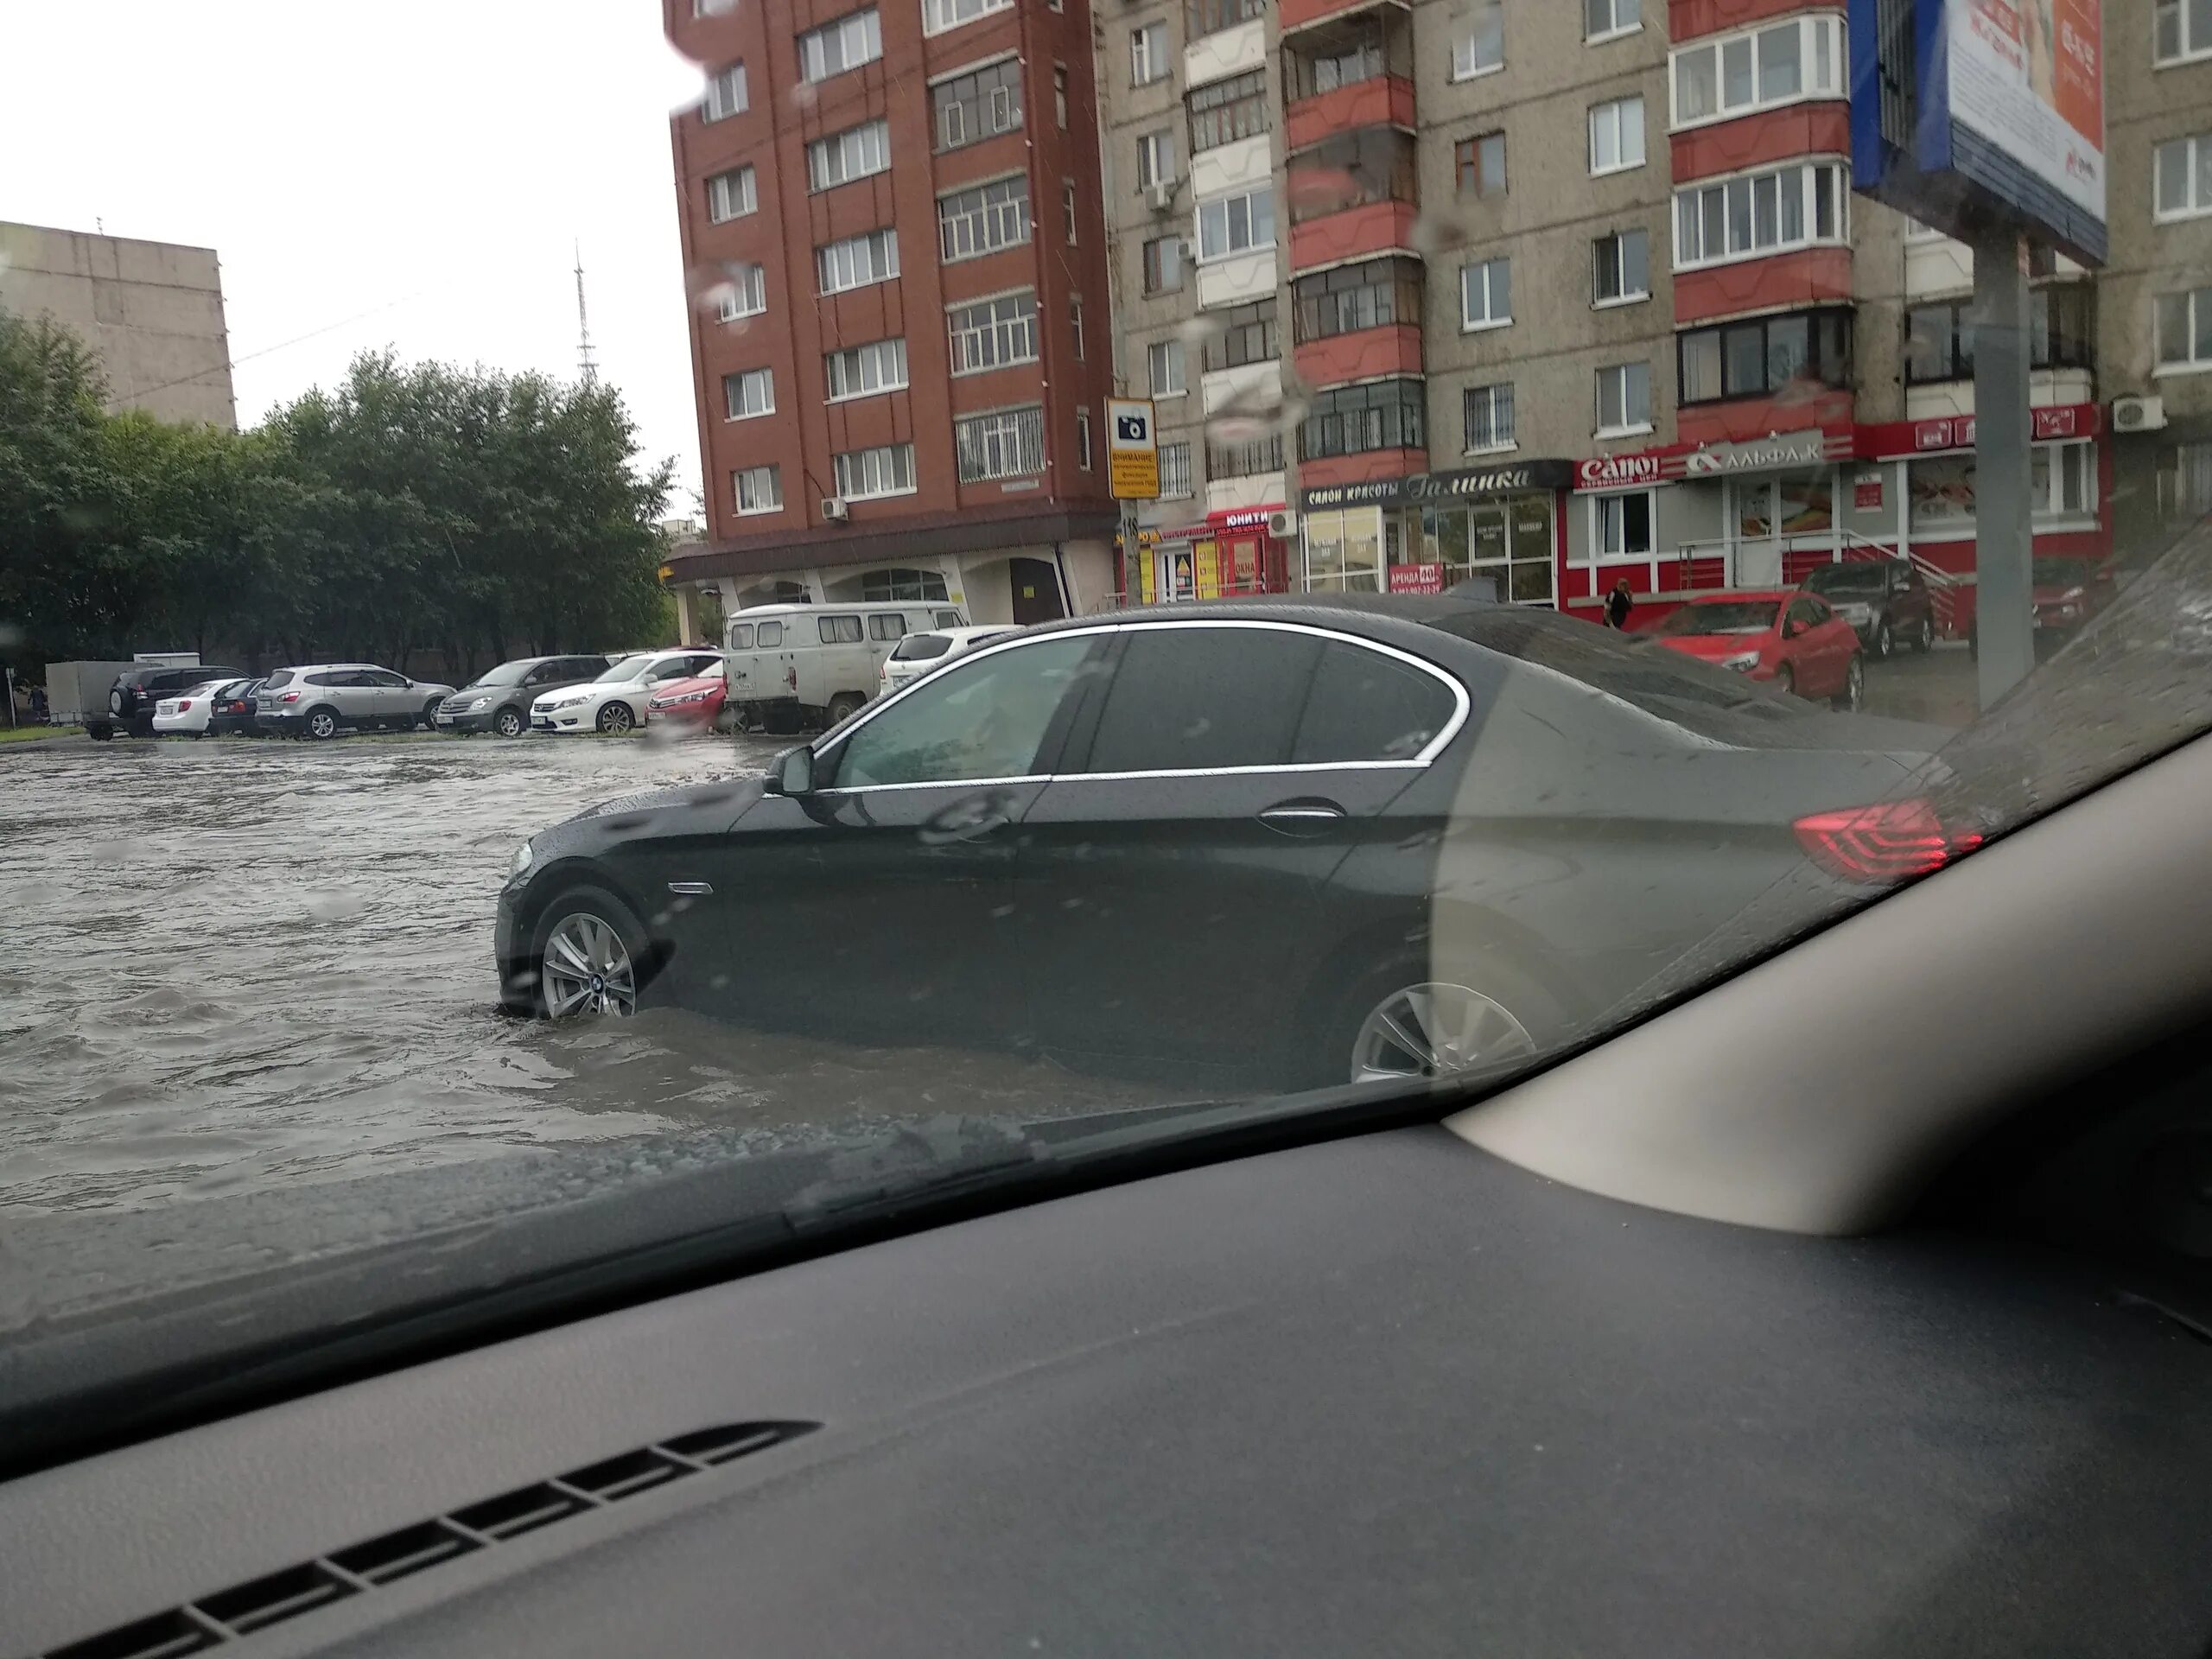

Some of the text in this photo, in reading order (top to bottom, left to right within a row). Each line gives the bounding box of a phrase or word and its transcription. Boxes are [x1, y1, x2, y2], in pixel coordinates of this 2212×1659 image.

[1308, 469, 1530, 505] САЛОН КРАСОТЫ Галинка
[1226, 511, 1268, 526] ЮНИТИ
[1235, 563, 1255, 573] ОКНА
[1391, 571, 1420, 585] АРЕНДА
